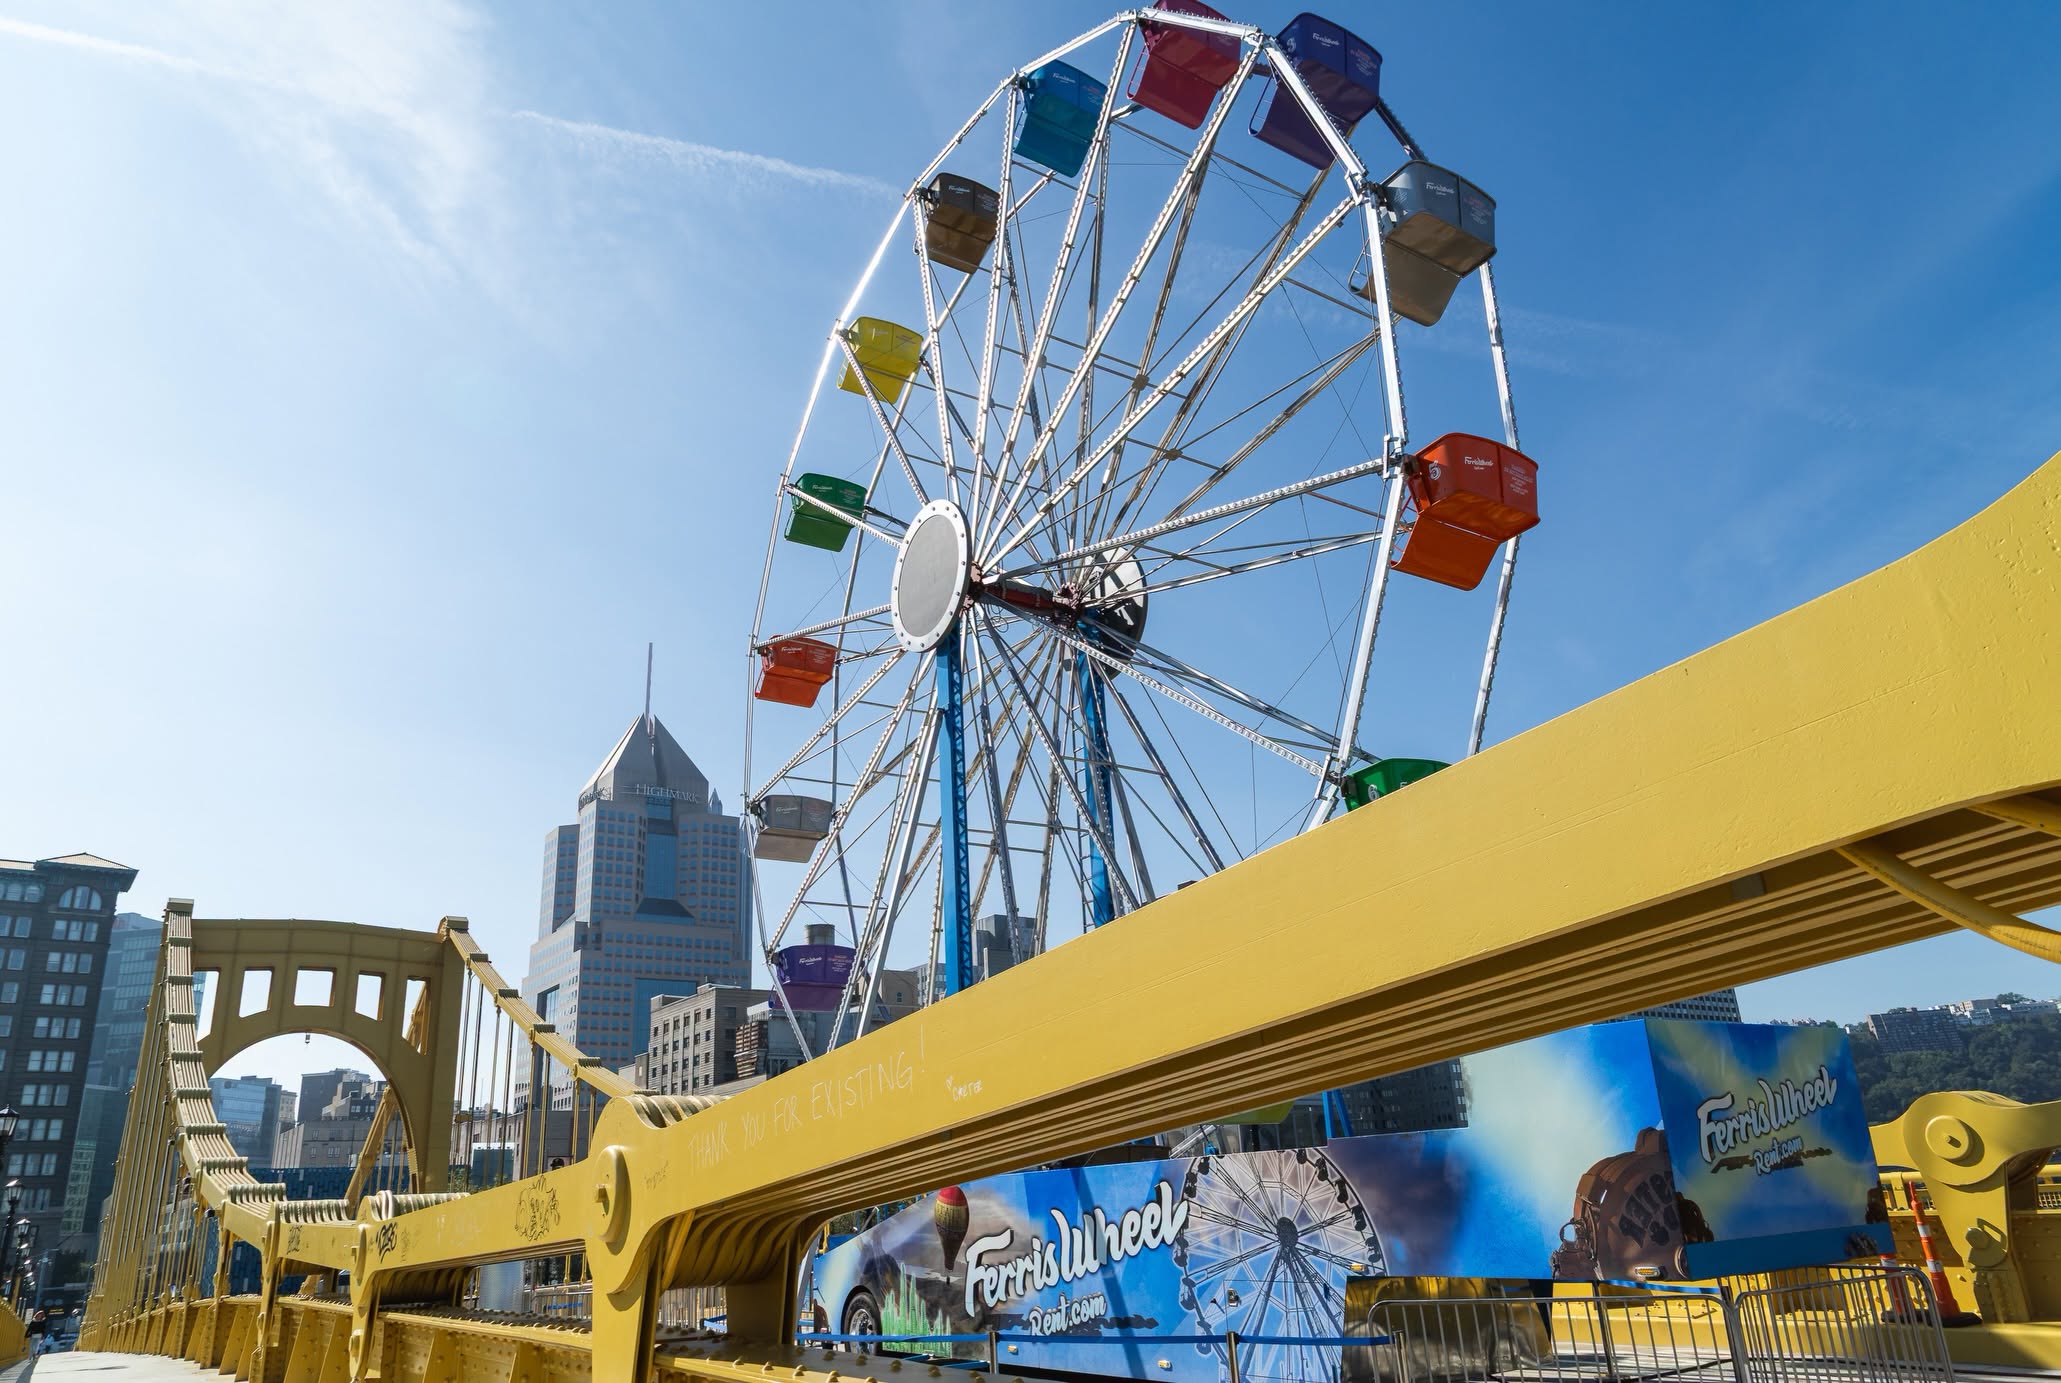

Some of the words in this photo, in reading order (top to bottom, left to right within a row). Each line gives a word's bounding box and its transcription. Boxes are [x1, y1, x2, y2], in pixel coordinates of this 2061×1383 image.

[1429, 460, 1442, 481] 5
[636, 784, 697, 804] HIGHMARK
[1368, 784, 1379, 801] 6
[688, 1121, 730, 1176] THANK
[741, 1111, 766, 1152] YOU
[774, 1095, 803, 1136] FOR
[1754, 1135, 1803, 1176] Rent.com
[1029, 1291, 1107, 1336] Rent.com
